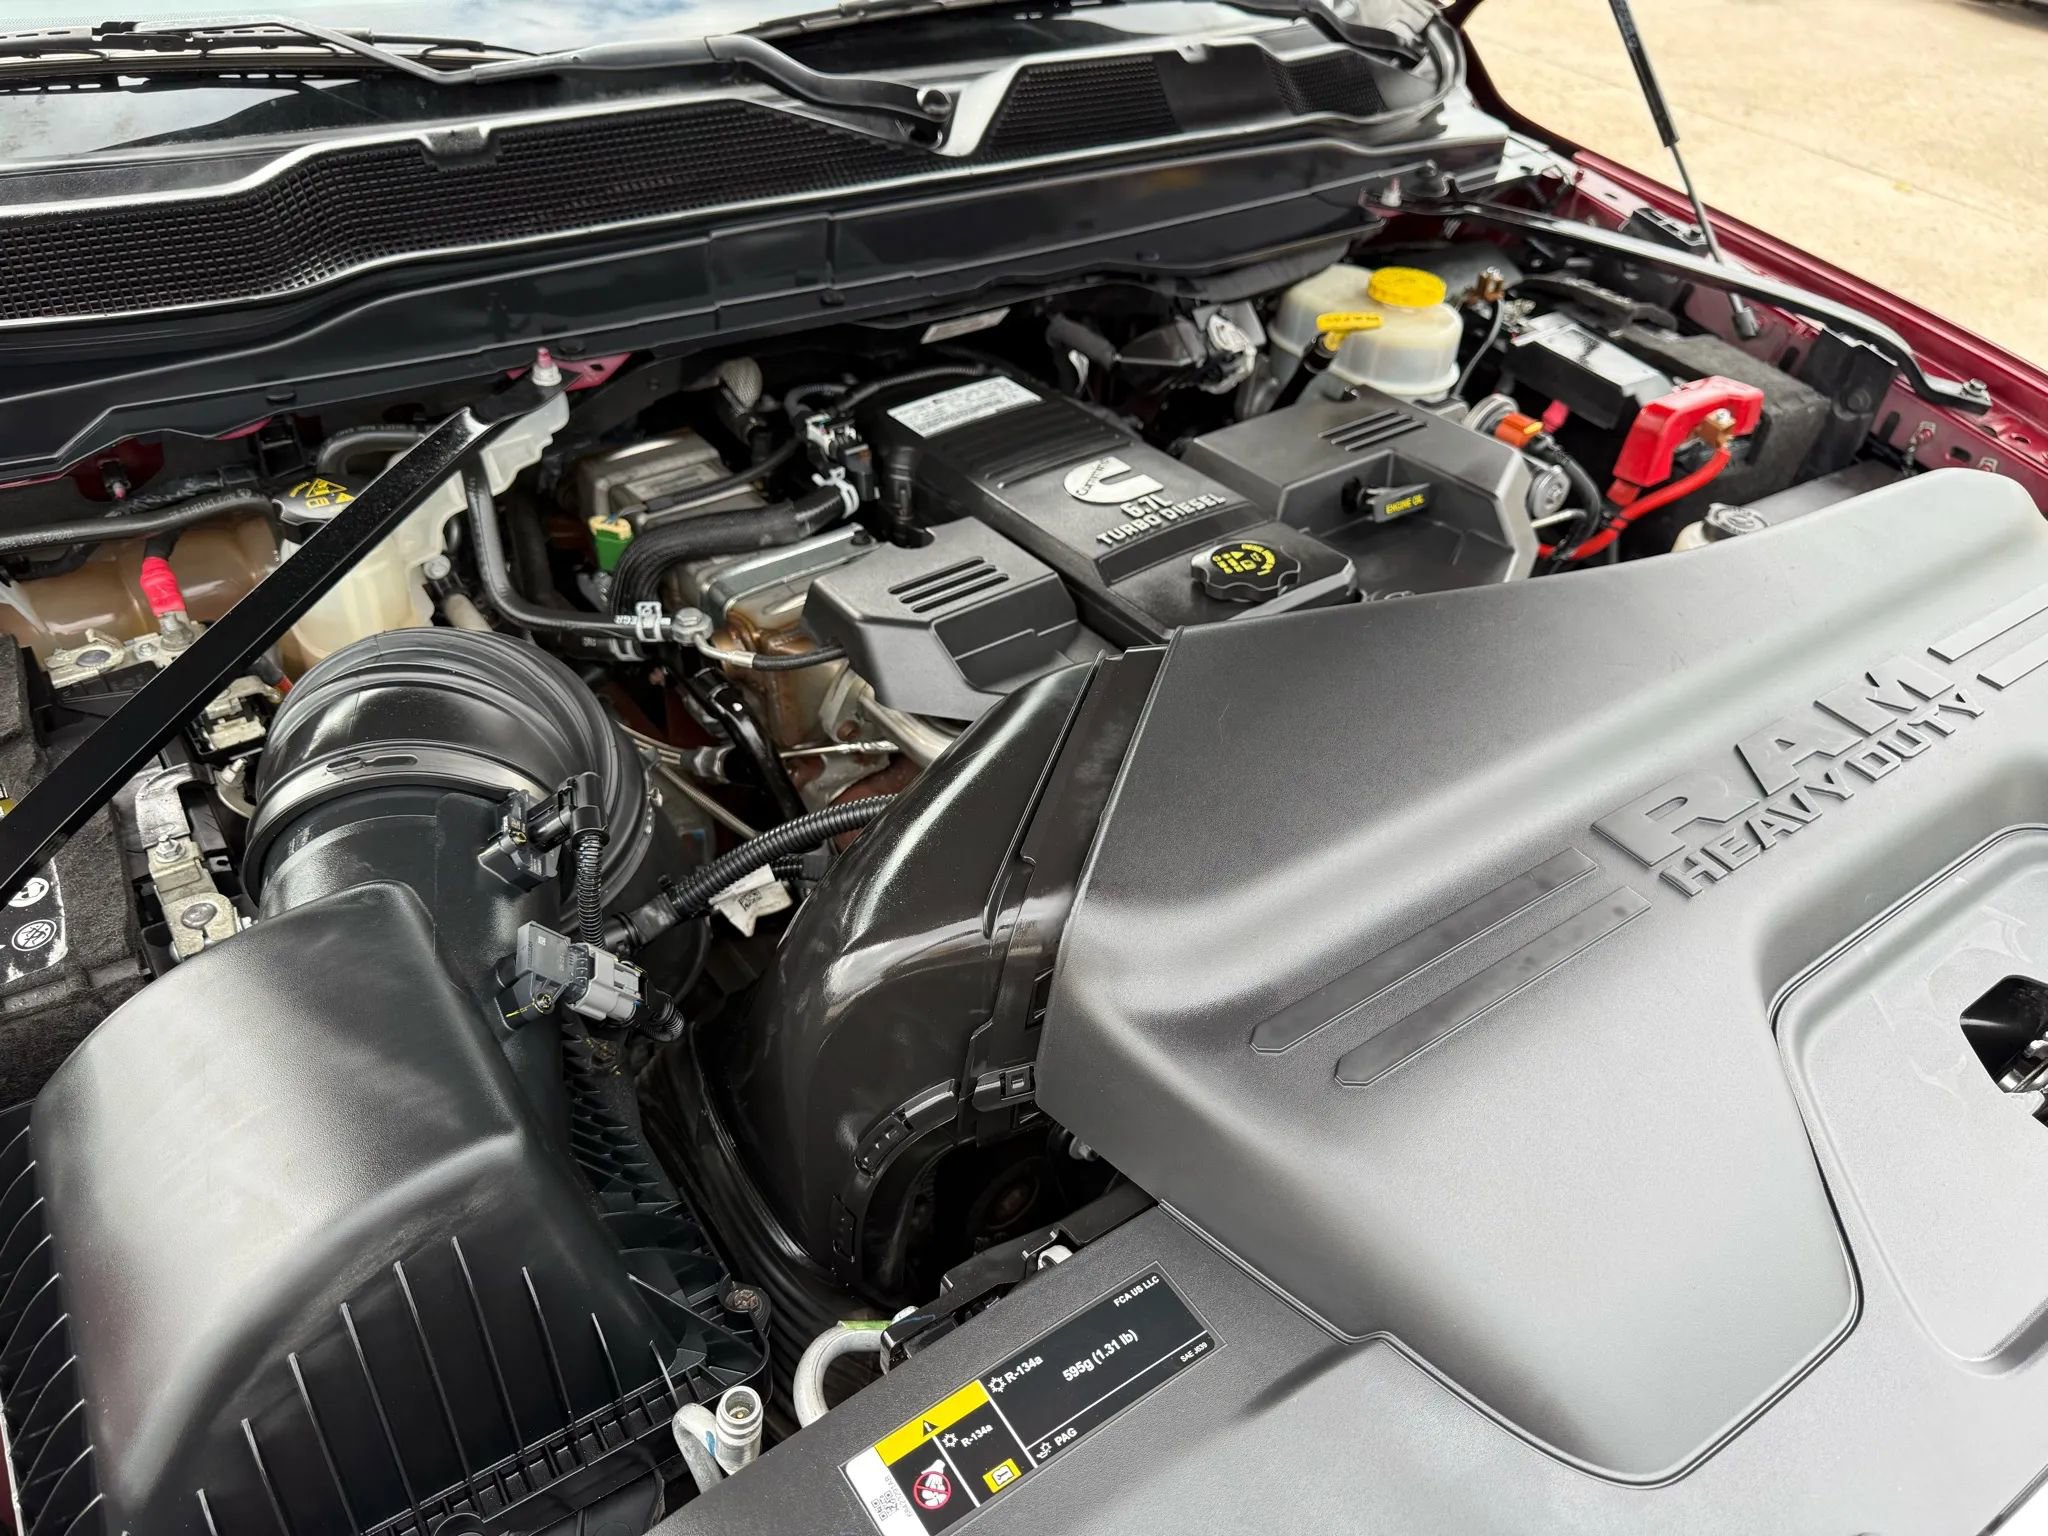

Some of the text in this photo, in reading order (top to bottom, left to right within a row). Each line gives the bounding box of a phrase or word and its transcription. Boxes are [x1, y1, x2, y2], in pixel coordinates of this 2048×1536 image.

[1097, 493, 1227, 547] TURBO DIESEL
[1120, 494, 1173, 518] 6.7L
[1385, 497, 1412, 515] ENGINE
[1591, 653, 1956, 868] RAM
[1658, 689, 1985, 898] HEAVY DUTY
[1113, 1275, 1160, 1307] FCA US LLC
[1004, 1355, 1043, 1383] R-134a
[1062, 1329, 1139, 1382] 595g (1.31 lb)
[1180, 1350, 1195, 1362] SAE
[960, 1424, 994, 1447] R-134a
[1053, 1427, 1078, 1447] PAG
